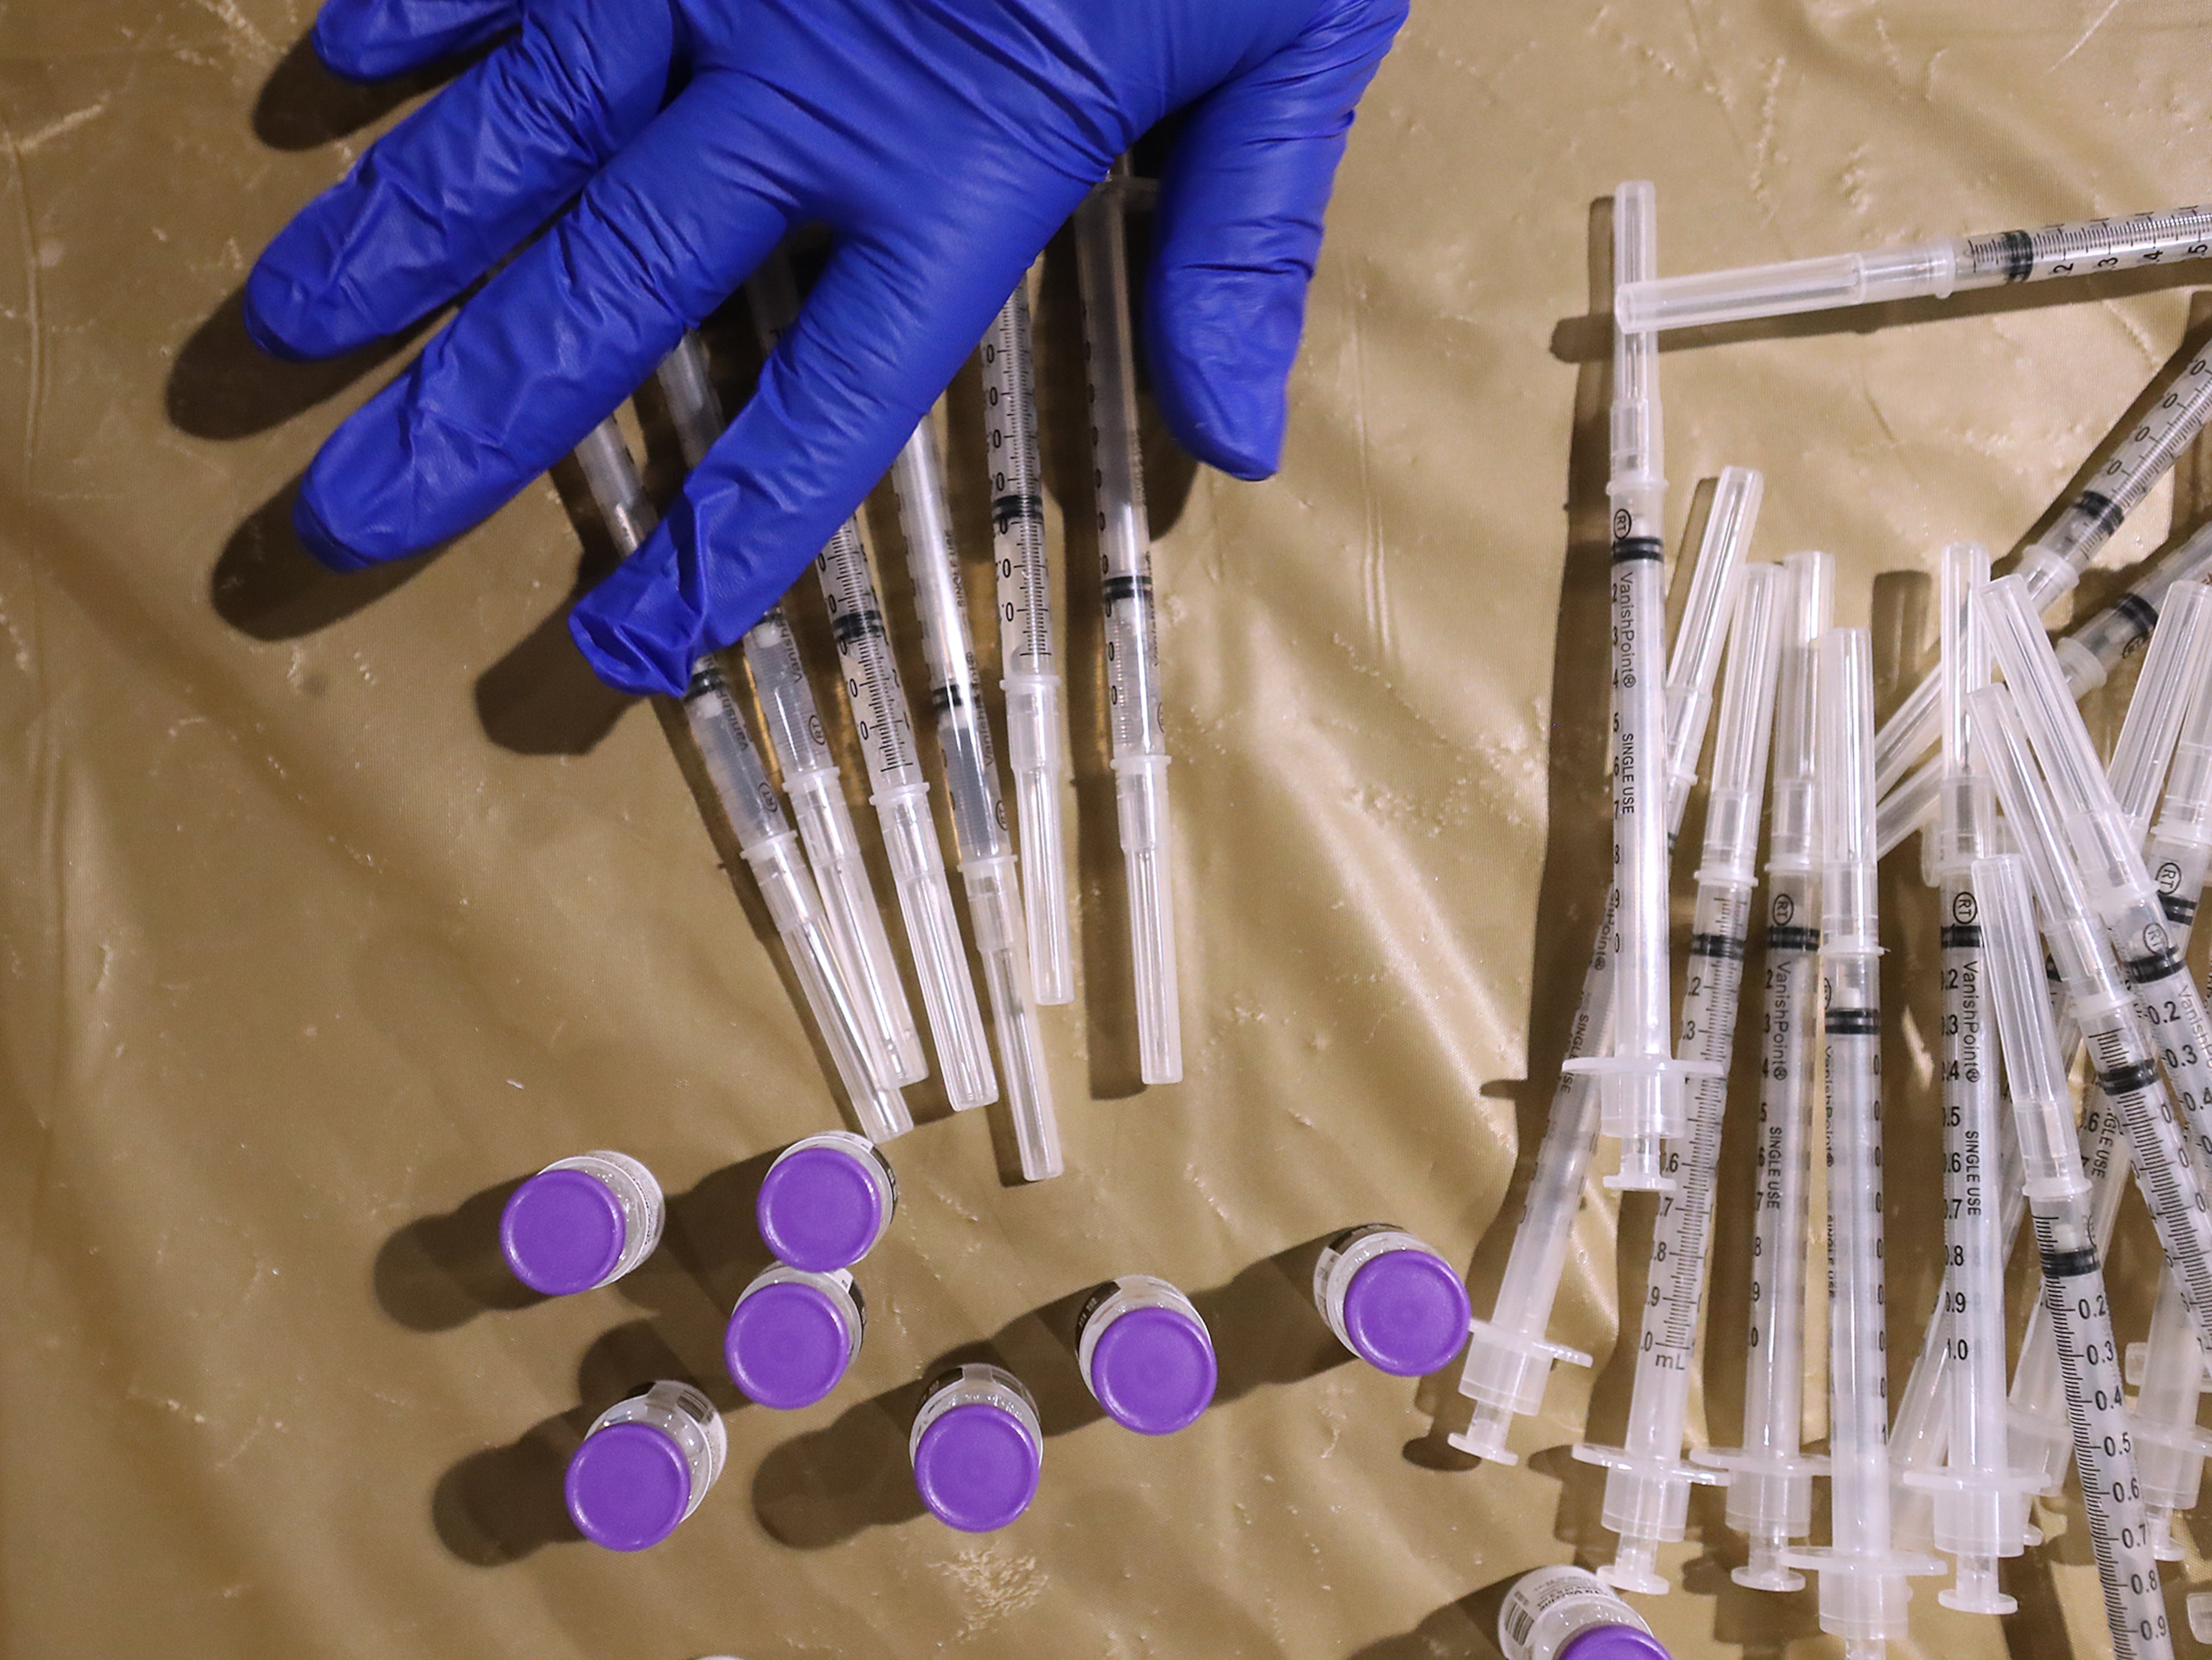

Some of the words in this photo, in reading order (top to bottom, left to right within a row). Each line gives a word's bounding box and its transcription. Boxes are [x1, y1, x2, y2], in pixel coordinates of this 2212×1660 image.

[1622, 733, 1634, 784] SINGLE
[1622, 787, 1634, 814] USE
[1941, 968, 1959, 990] .2
[1941, 1014, 1959, 1036] .3
[1963, 961, 1980, 1083] VanishPoint®
[2147, 1001, 2180, 1025] 0.2
[2165, 1044, 2198, 1068] 0.3
[1942, 1060, 1960, 1081] .4
[1768, 1127, 1782, 1177] SINGLE
[1965, 1131, 1980, 1183] SINGLE
[2092, 1150, 2110, 1178] USE
[1767, 1181, 1780, 1209] USE
[1967, 1187, 1981, 1216] USE
[2078, 1295, 2107, 1320] 0.2
[1656, 1353, 1685, 1370] mL
[2086, 1340, 2114, 1365] 0.3
[2094, 1385, 2123, 1411] 0.4
[2103, 1432, 2131, 1457] 0.5
[2112, 1477, 2140, 1503] 0.6
[2121, 1523, 2149, 1549] 0.7
[2131, 1570, 2158, 1595] 0.8
[2140, 1615, 2167, 1641] 0.9
